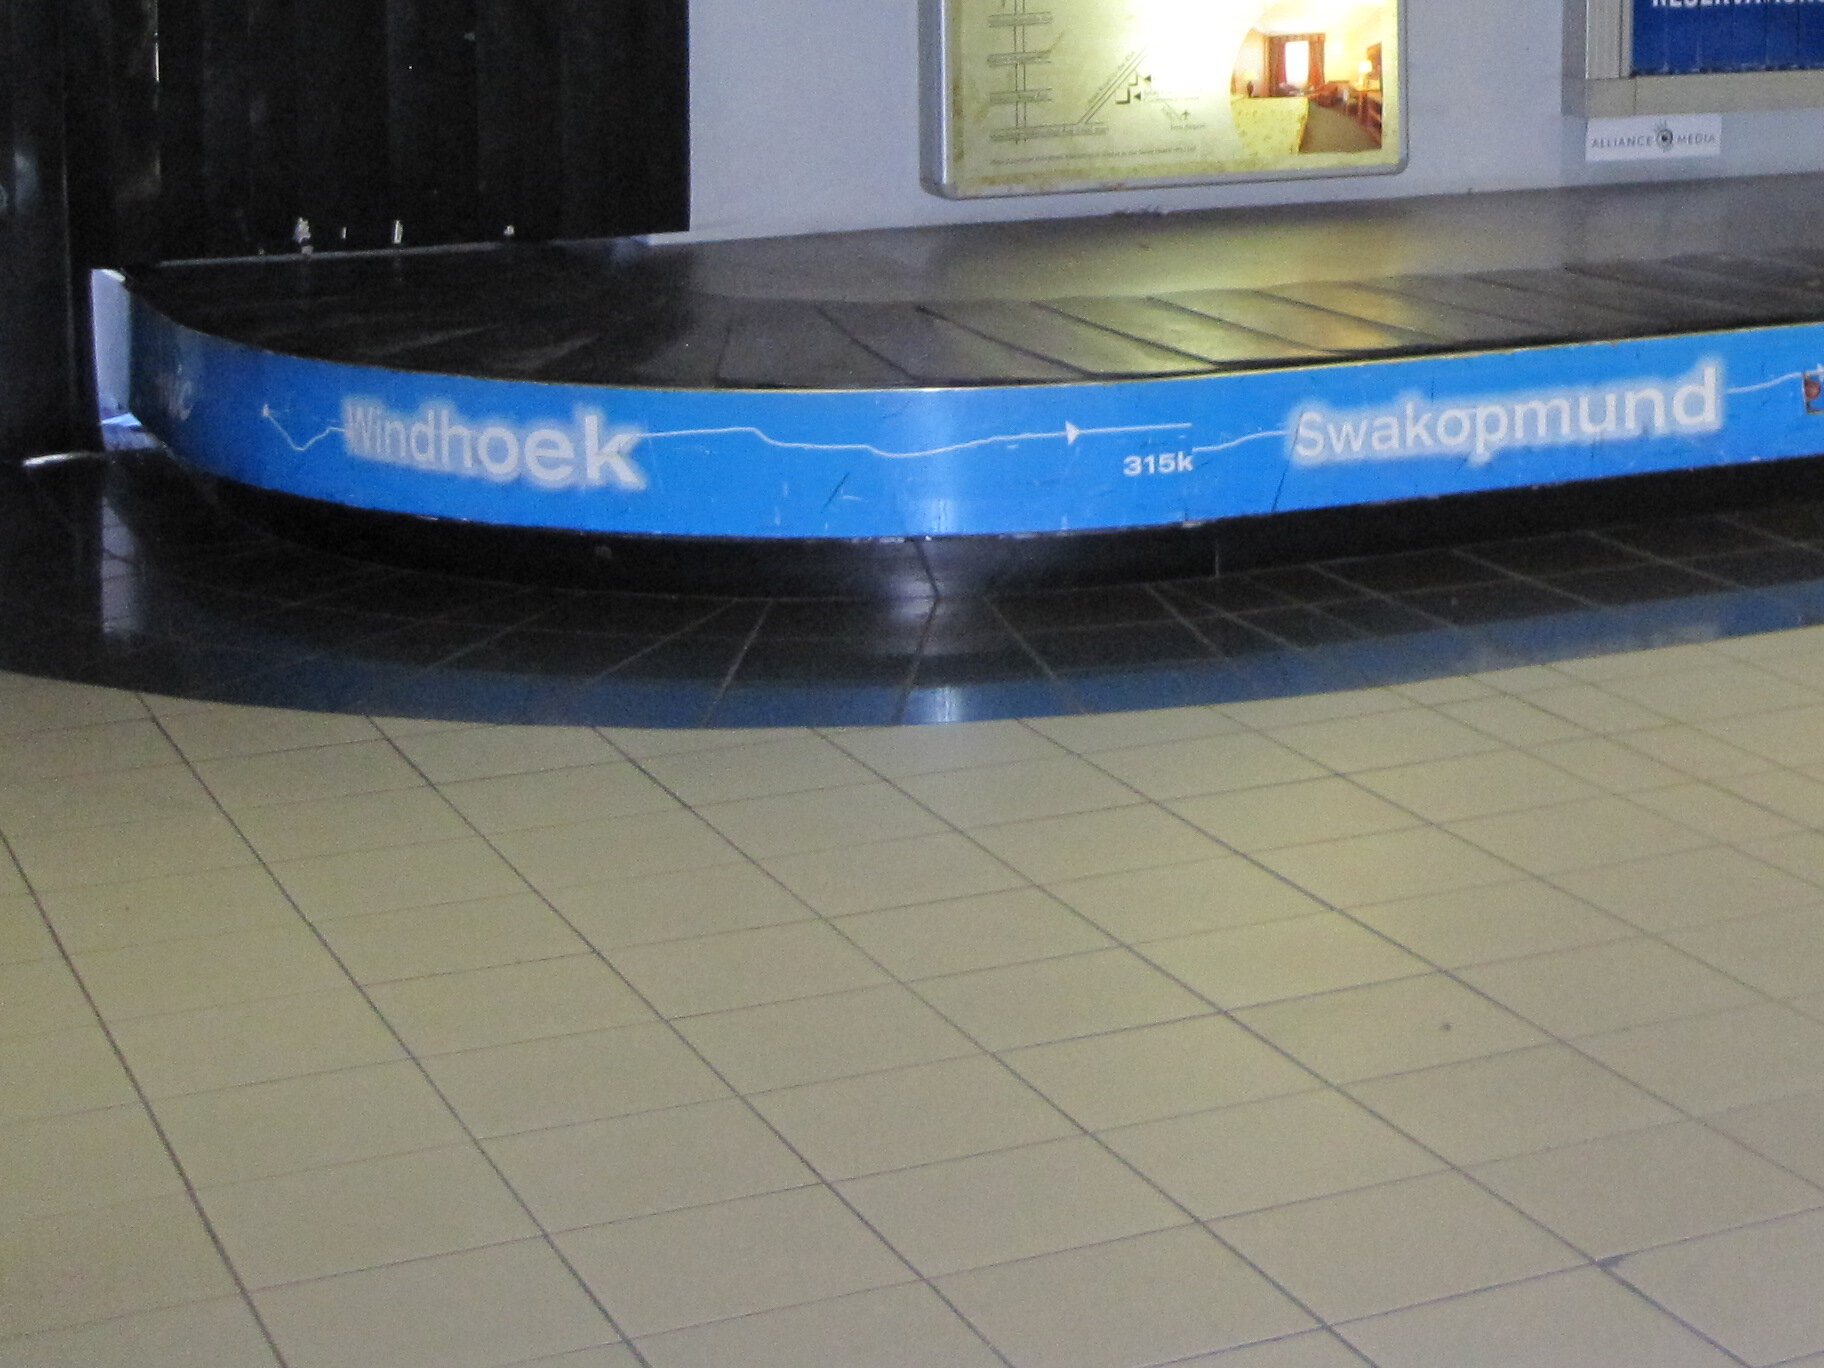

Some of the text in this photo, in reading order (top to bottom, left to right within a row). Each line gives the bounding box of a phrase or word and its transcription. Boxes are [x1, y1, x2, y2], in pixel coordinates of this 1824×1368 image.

[1592, 133, 1715, 148] ALLIANCE MEDIA
[1296, 365, 1719, 456] Swakopmund
[346, 402, 646, 488] Windhoek
[1123, 451, 1194, 476] 315k
